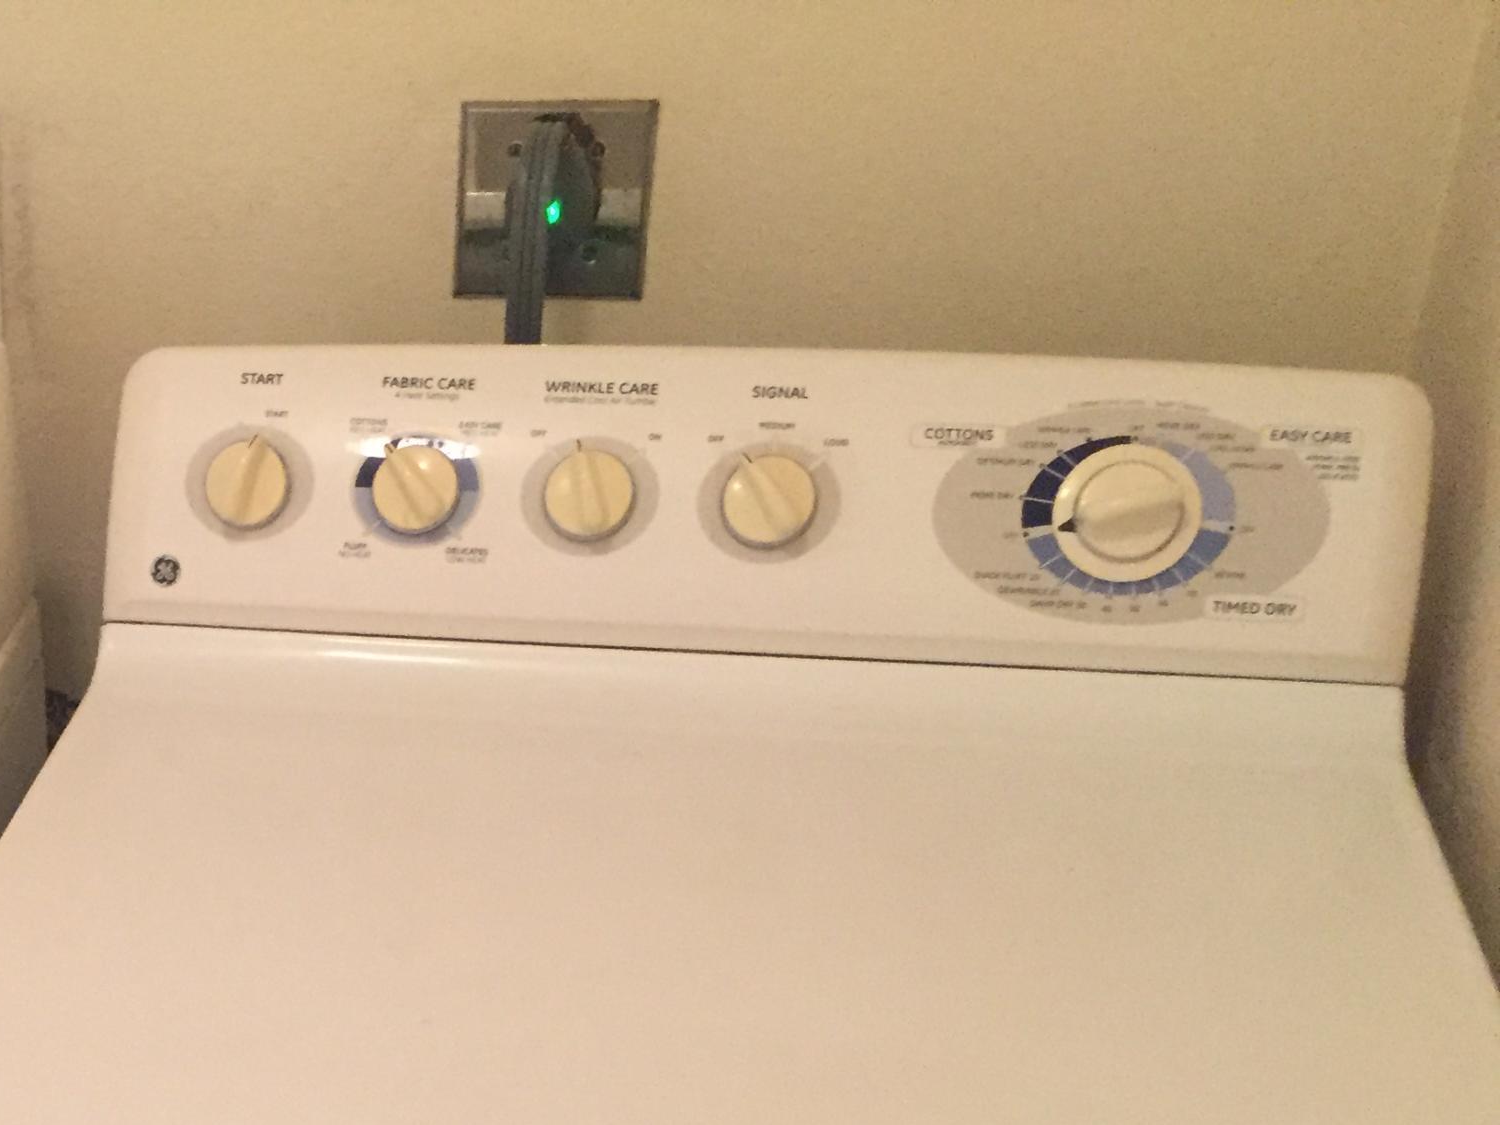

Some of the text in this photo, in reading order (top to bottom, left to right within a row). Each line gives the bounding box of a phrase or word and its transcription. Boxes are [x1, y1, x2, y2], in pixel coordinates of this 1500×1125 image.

[240, 372, 284, 385] START
[382, 376, 476, 391] FABRIC CARE
[545, 380, 659, 396] WRINKLE CARE
[752, 385, 808, 399] SIGNAL
[924, 428, 994, 441] COTTONS
[1269, 430, 1352, 444] EASY CARE
[1213, 600, 1297, 615] TIMED DRY
